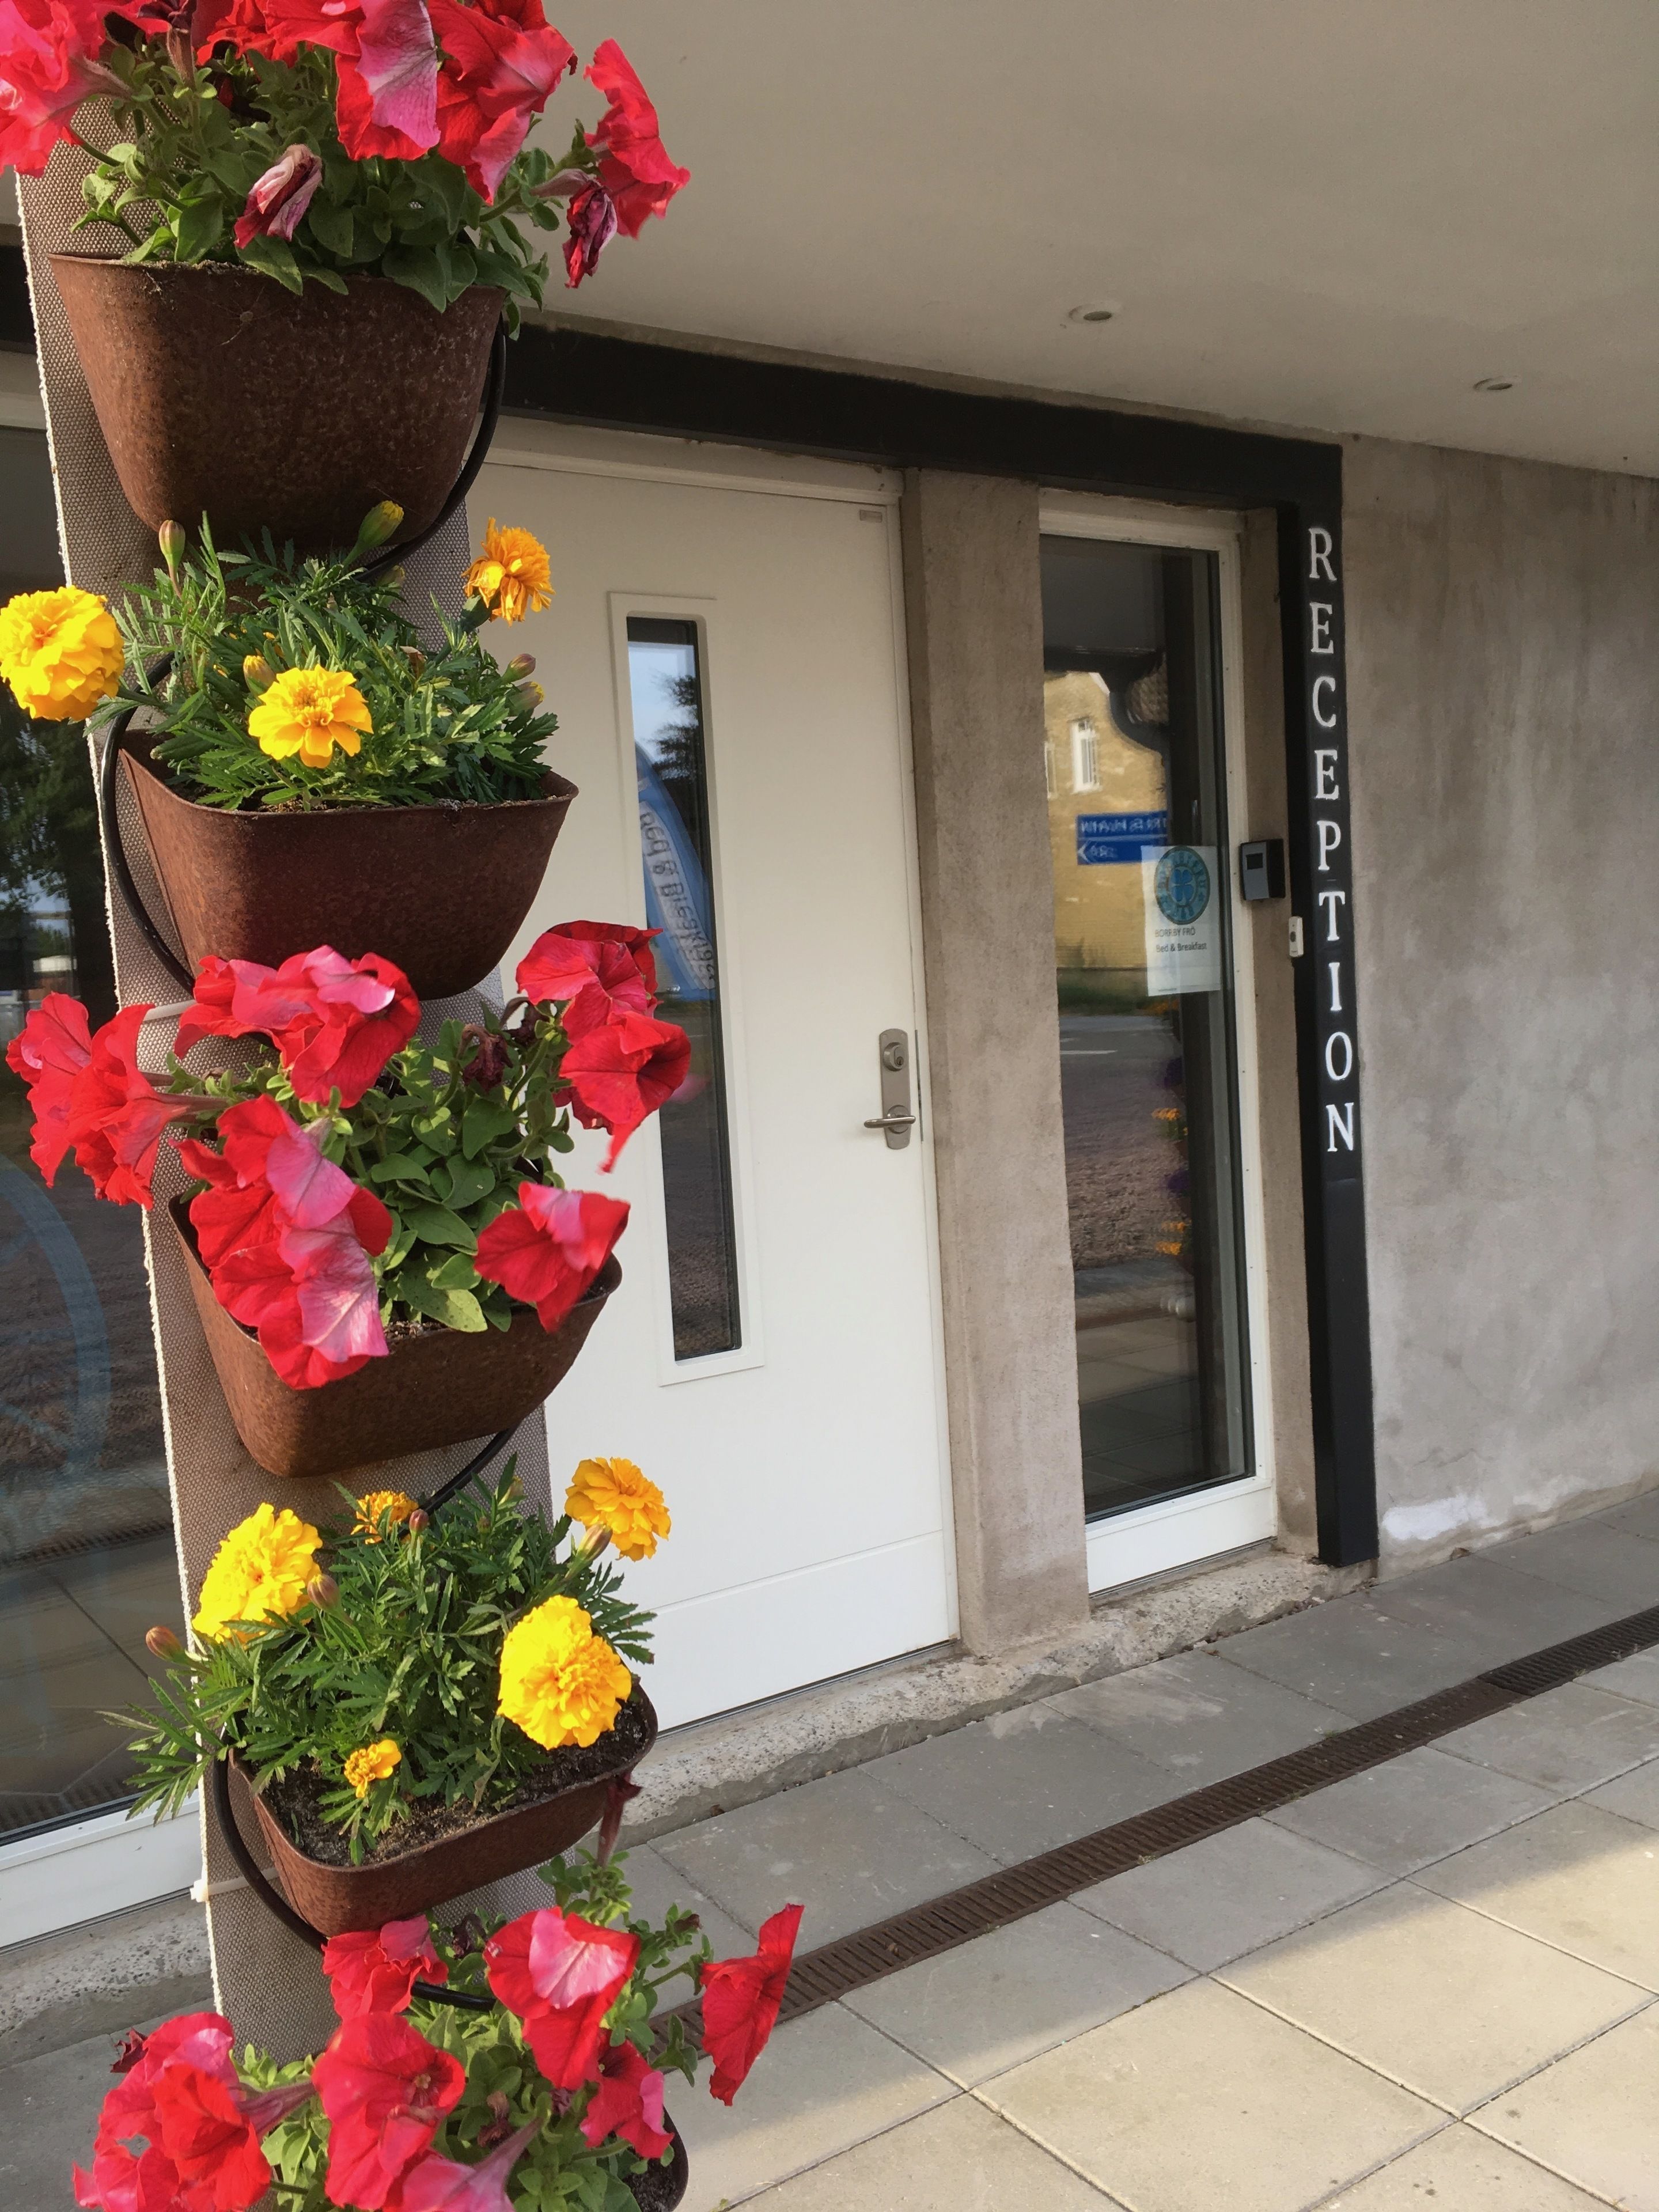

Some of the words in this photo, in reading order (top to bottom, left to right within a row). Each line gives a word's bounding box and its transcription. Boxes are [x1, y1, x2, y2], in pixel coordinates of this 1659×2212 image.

[1308, 528, 1354, 1152] RECEPTION
[1183, 926, 1195, 935] FRÖ
[1156, 944, 1168, 952] Bed
[1171, 943, 1175, 952] &
[1177, 941, 1207, 951] Breakfast
